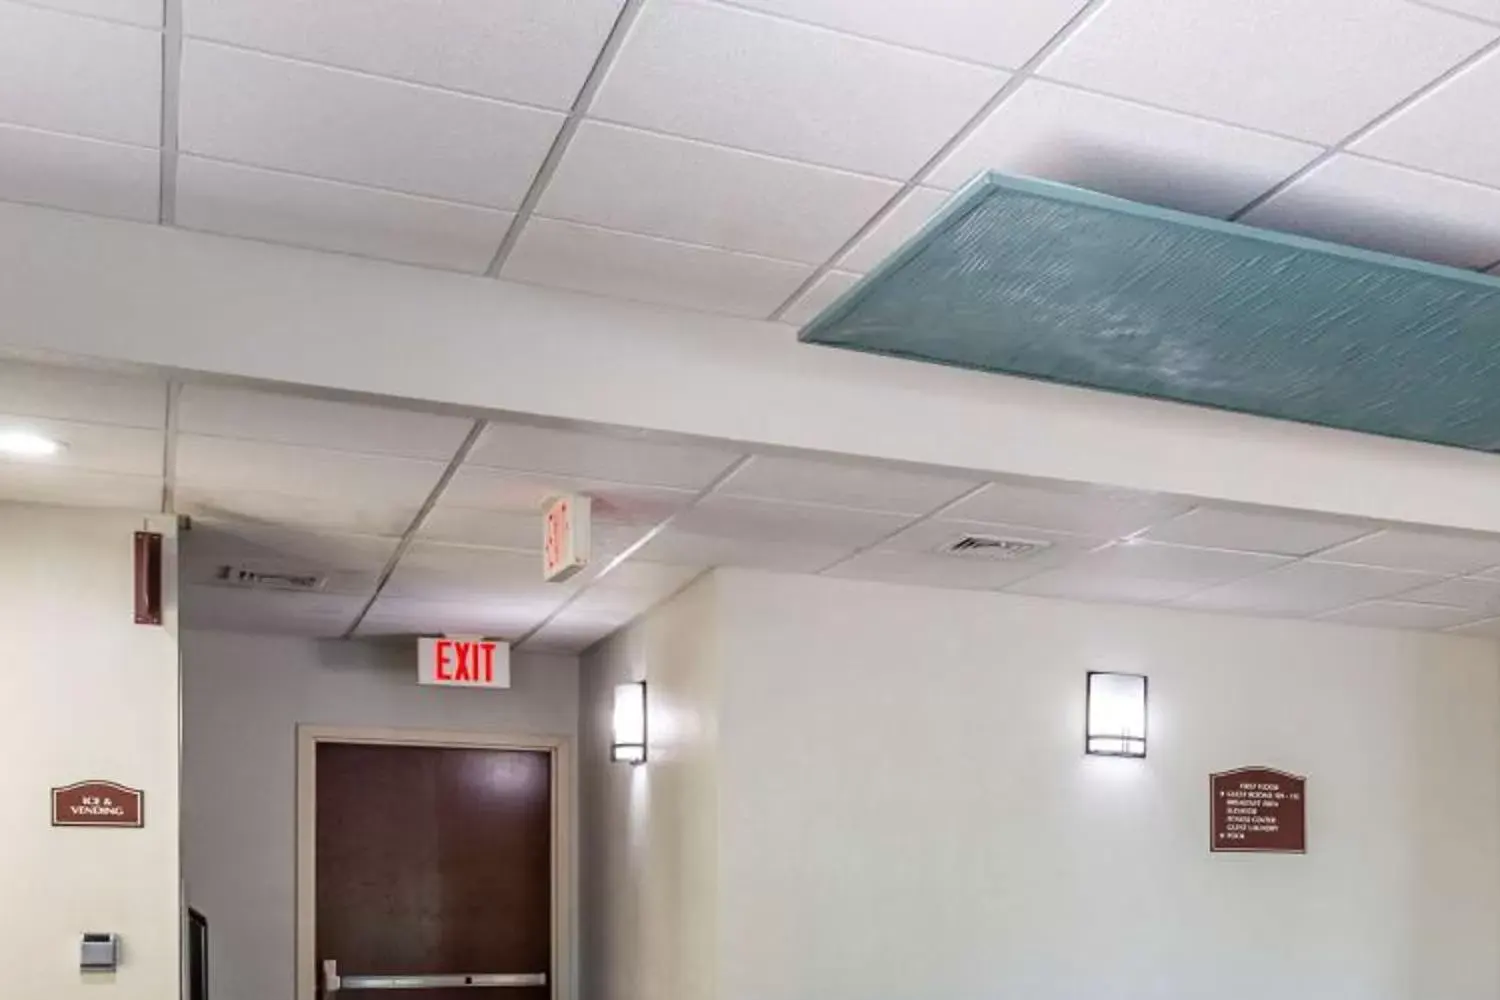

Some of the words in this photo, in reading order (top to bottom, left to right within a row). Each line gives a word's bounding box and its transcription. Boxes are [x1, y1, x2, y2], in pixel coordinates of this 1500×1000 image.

[436, 640, 497, 683] EXIT
[82, 796, 101, 805] ICE
[103, 797, 113, 806] &
[70, 805, 124, 816] VENDING
